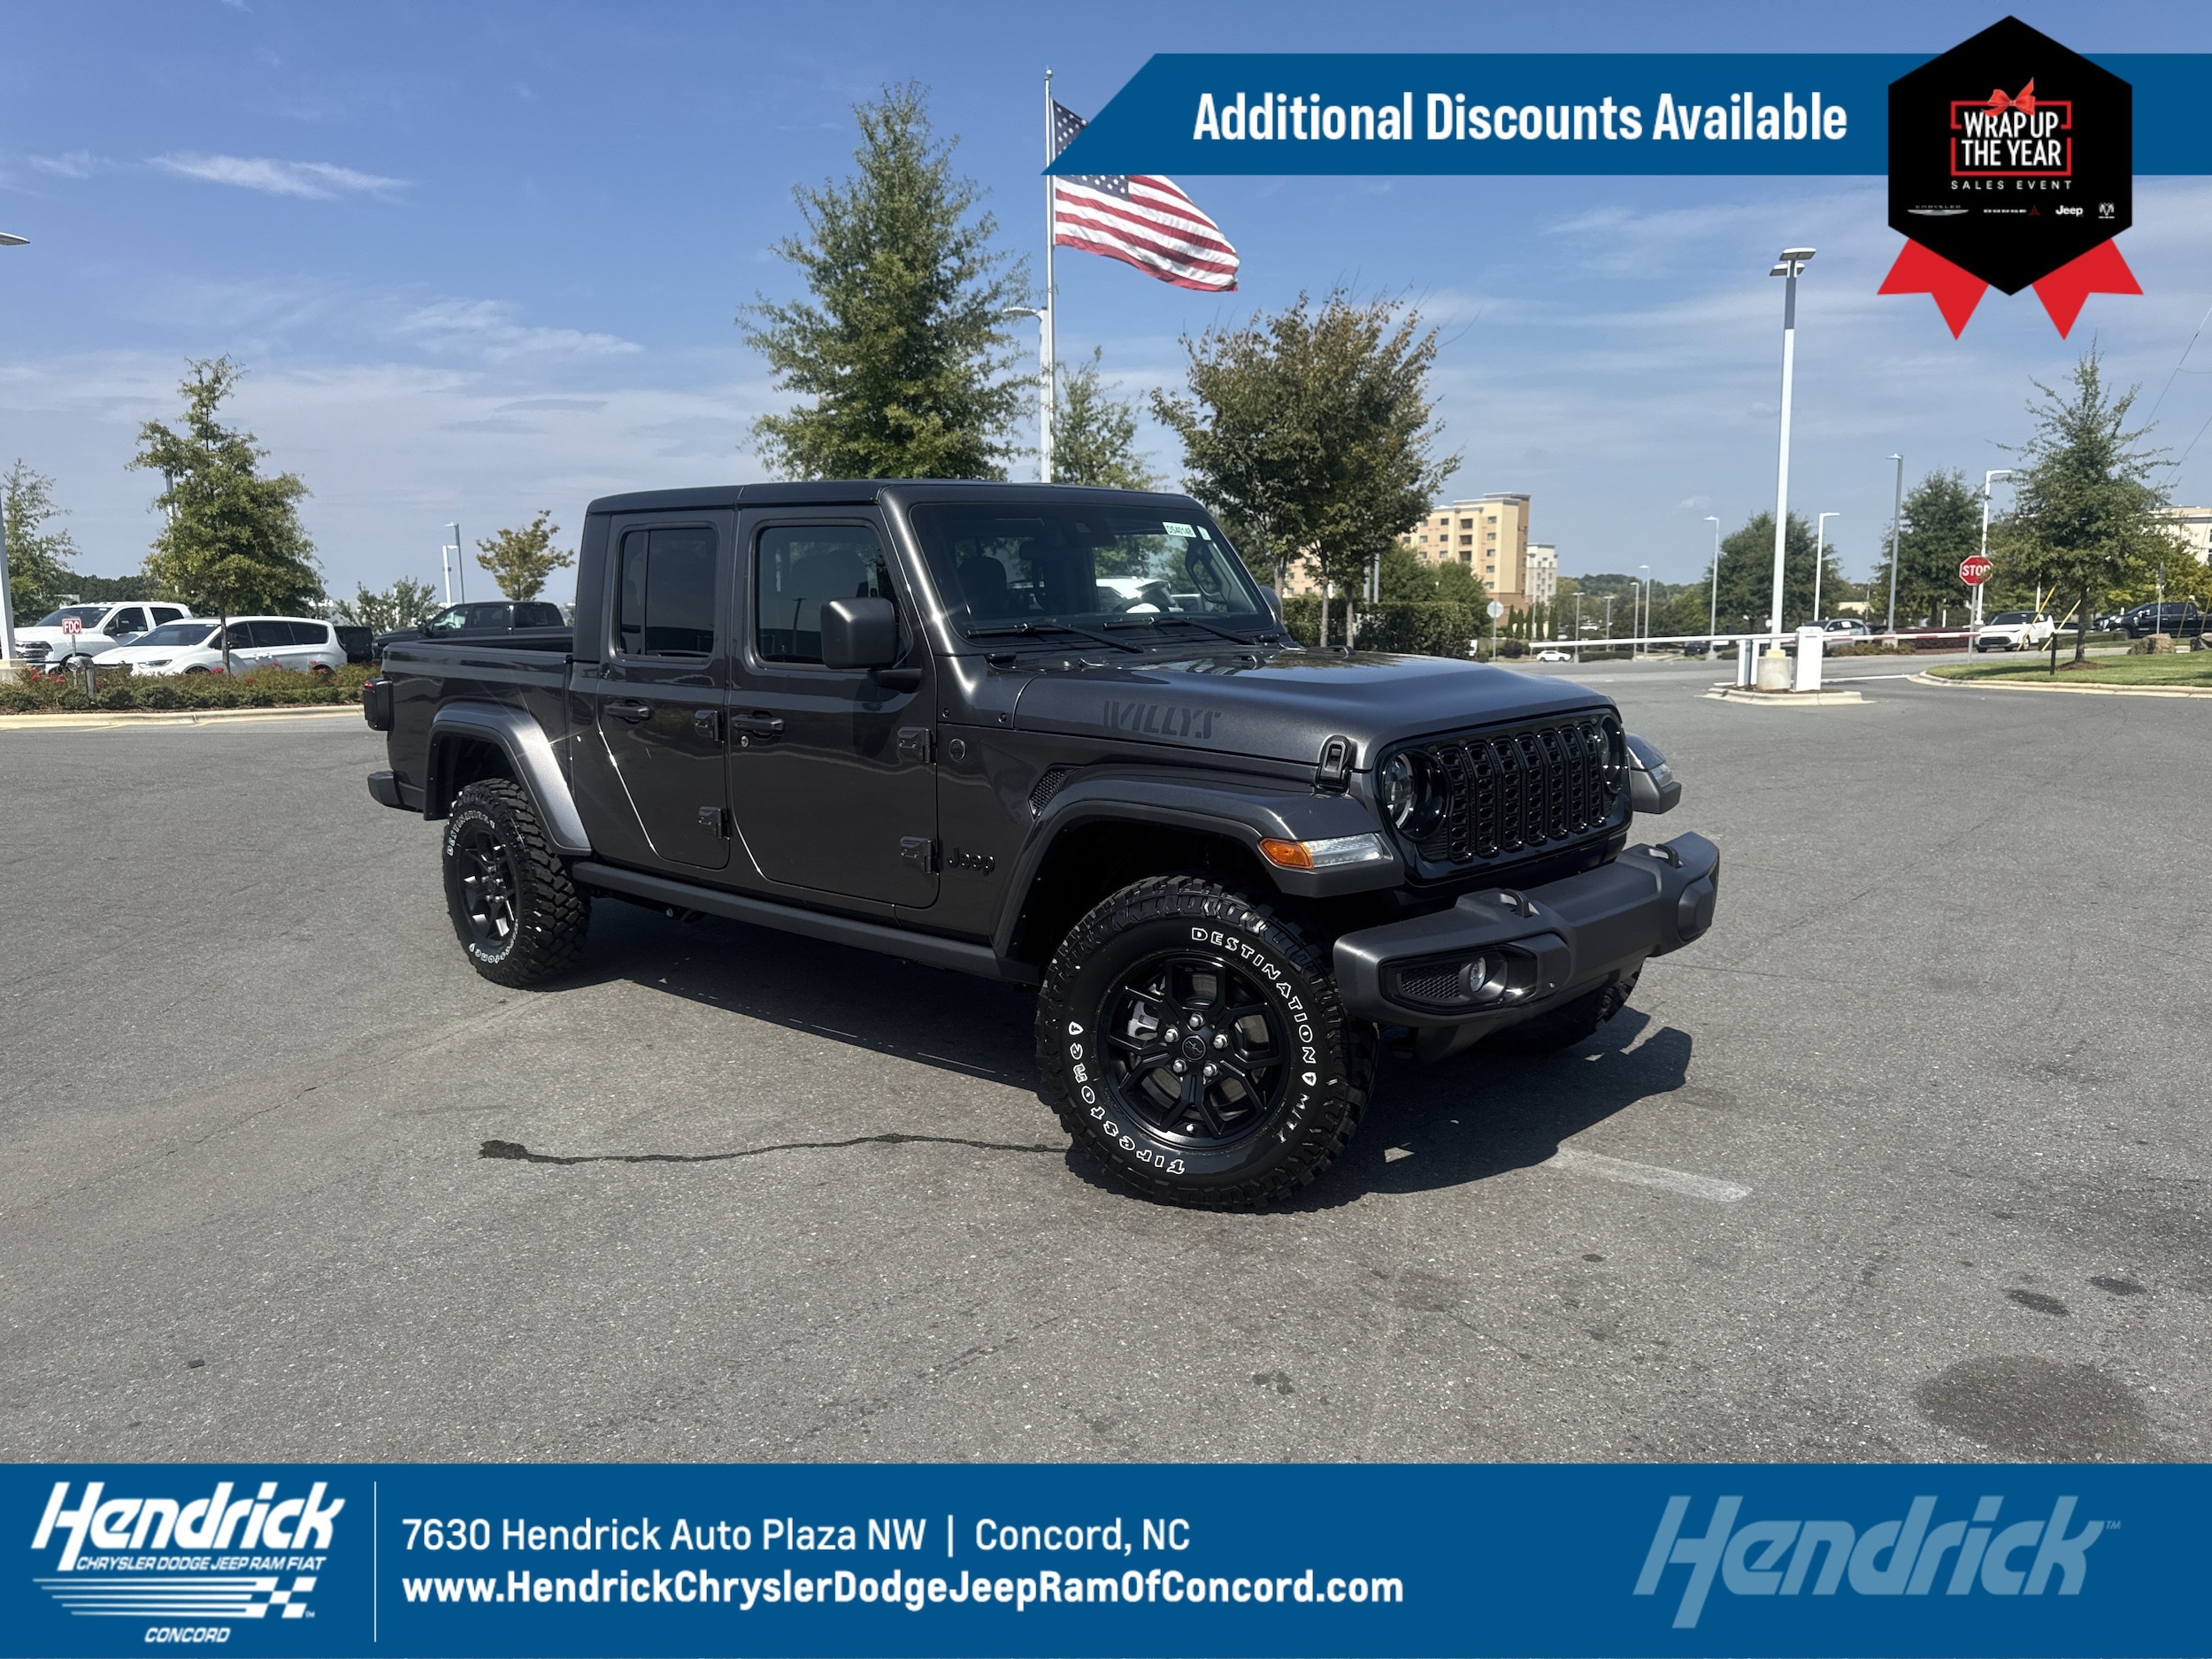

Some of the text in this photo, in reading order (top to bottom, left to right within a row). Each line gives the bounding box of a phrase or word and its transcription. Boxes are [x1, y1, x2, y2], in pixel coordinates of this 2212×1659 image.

[64, 620, 80, 633] FDC
[1103, 700, 1221, 739] WILLYS
[947, 847, 995, 876] Jeep
[1190, 926, 1317, 1065] DESTINATION
